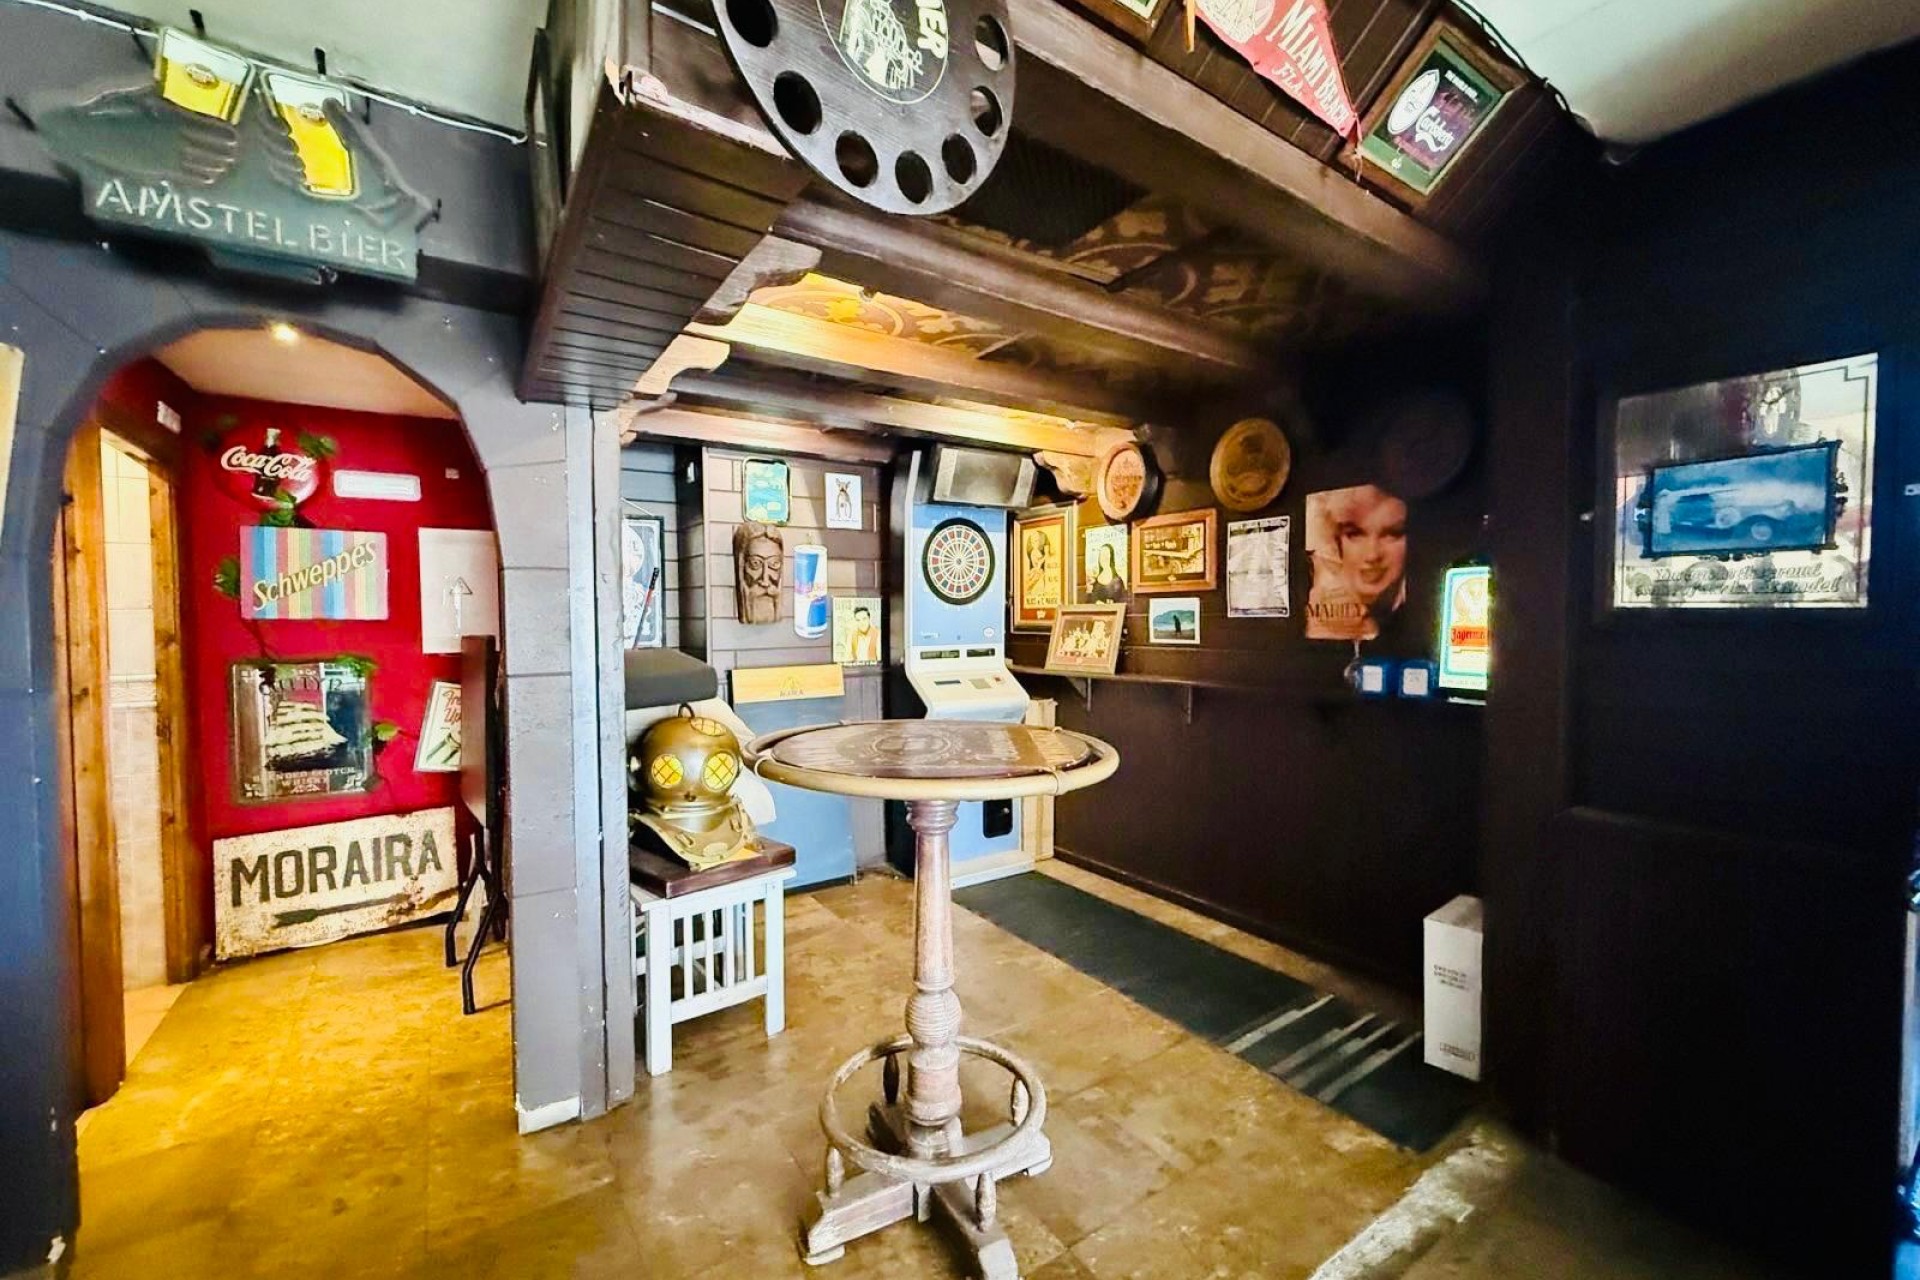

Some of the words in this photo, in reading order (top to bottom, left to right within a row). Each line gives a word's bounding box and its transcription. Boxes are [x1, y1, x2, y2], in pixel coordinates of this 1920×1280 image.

[1265, 0, 1328, 88] MIAMI
[1313, 66, 1350, 126] BEACH
[96, 178, 299, 248] AMSTEL
[252, 539, 377, 613] Schweppes
[230, 829, 443, 907] MORAIRA
